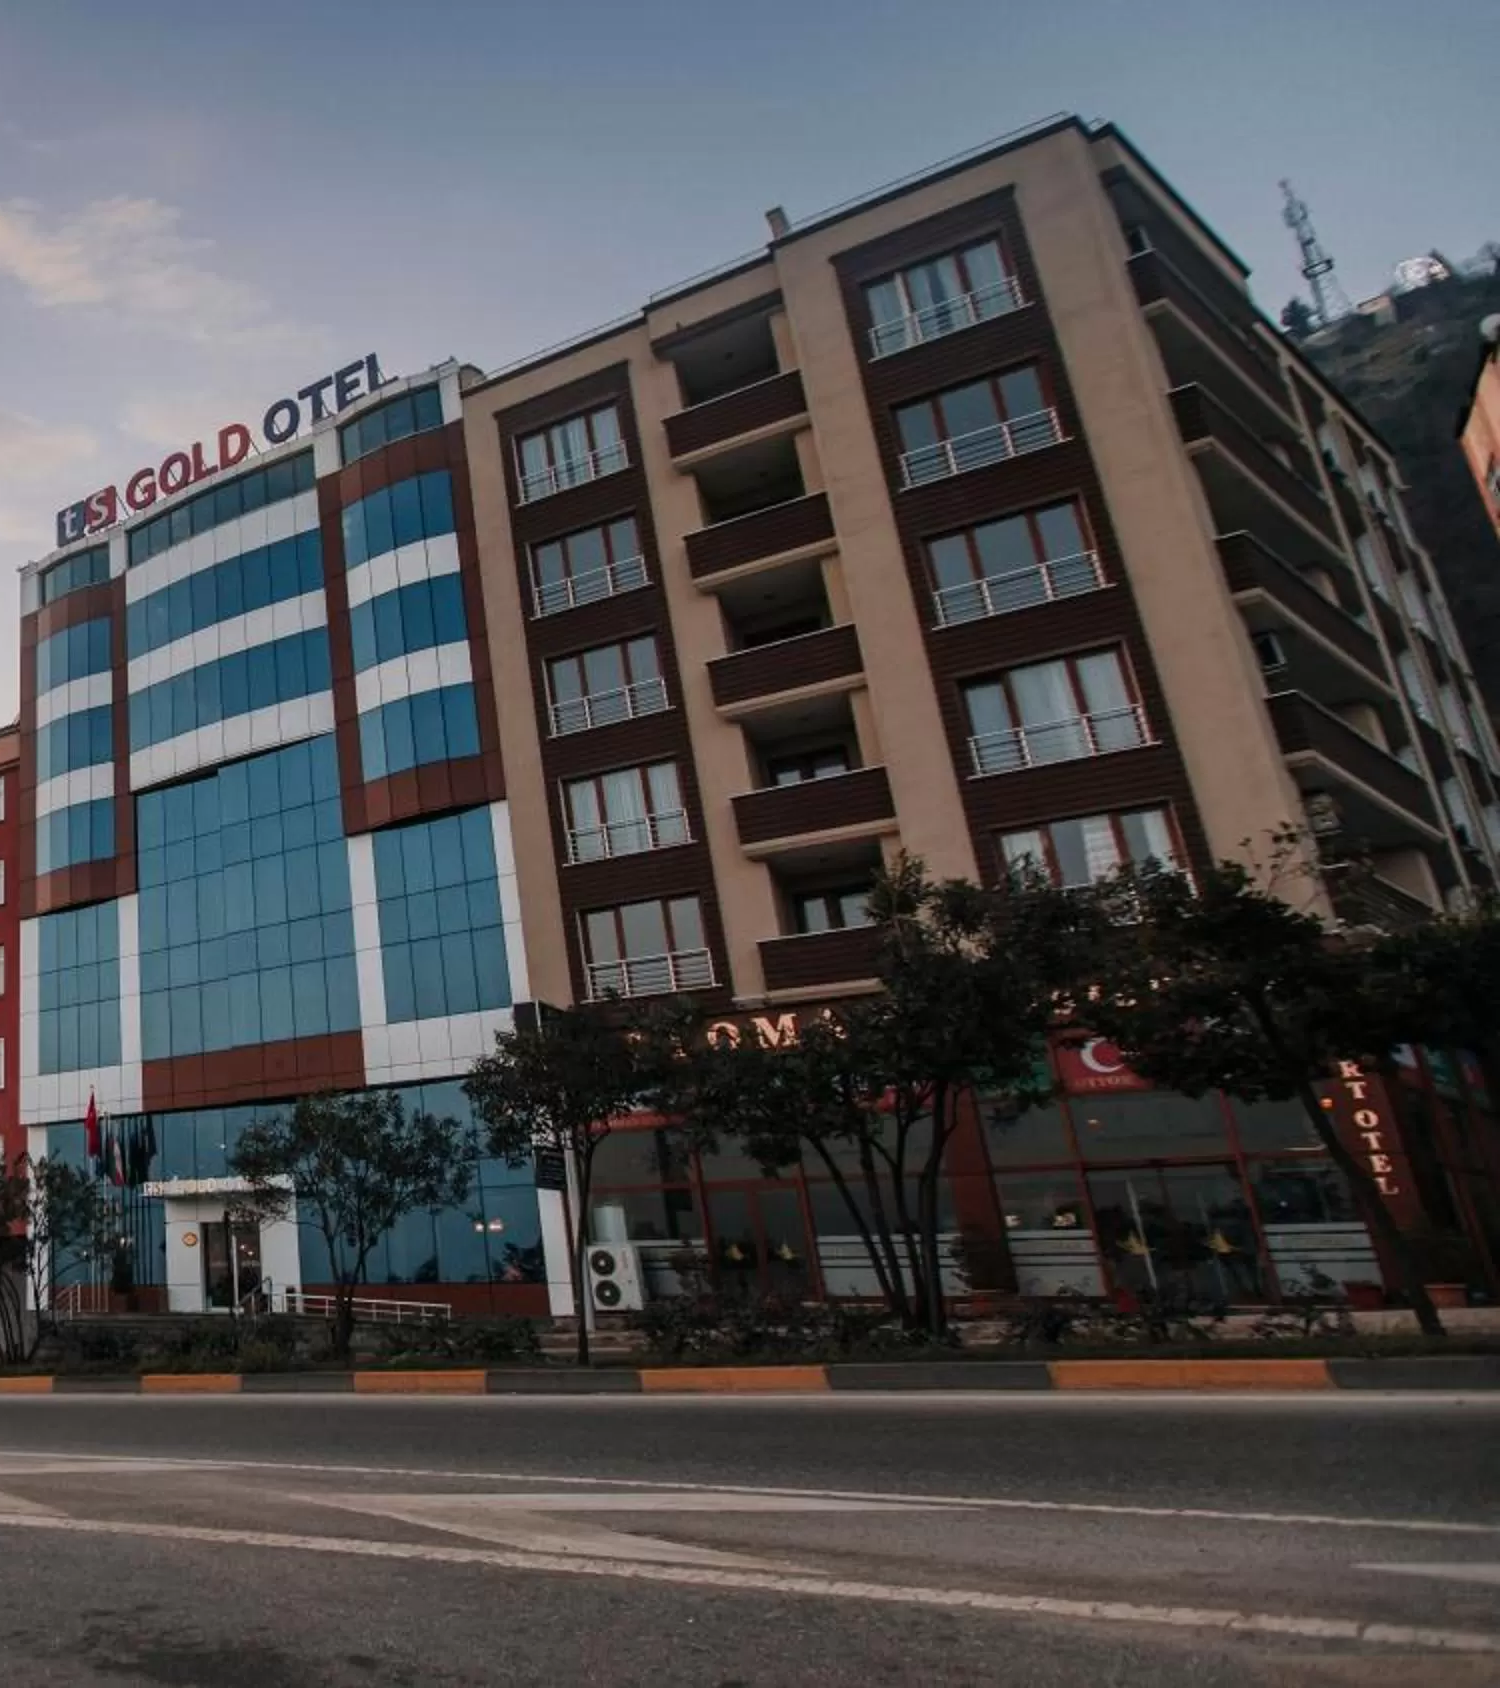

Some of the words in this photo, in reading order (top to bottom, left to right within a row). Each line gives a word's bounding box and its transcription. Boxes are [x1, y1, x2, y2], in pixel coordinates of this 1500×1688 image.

[126, 424, 251, 511] GOLD
[263, 352, 398, 444] OTEL
[1353, 1109, 1399, 1195] OTEL
